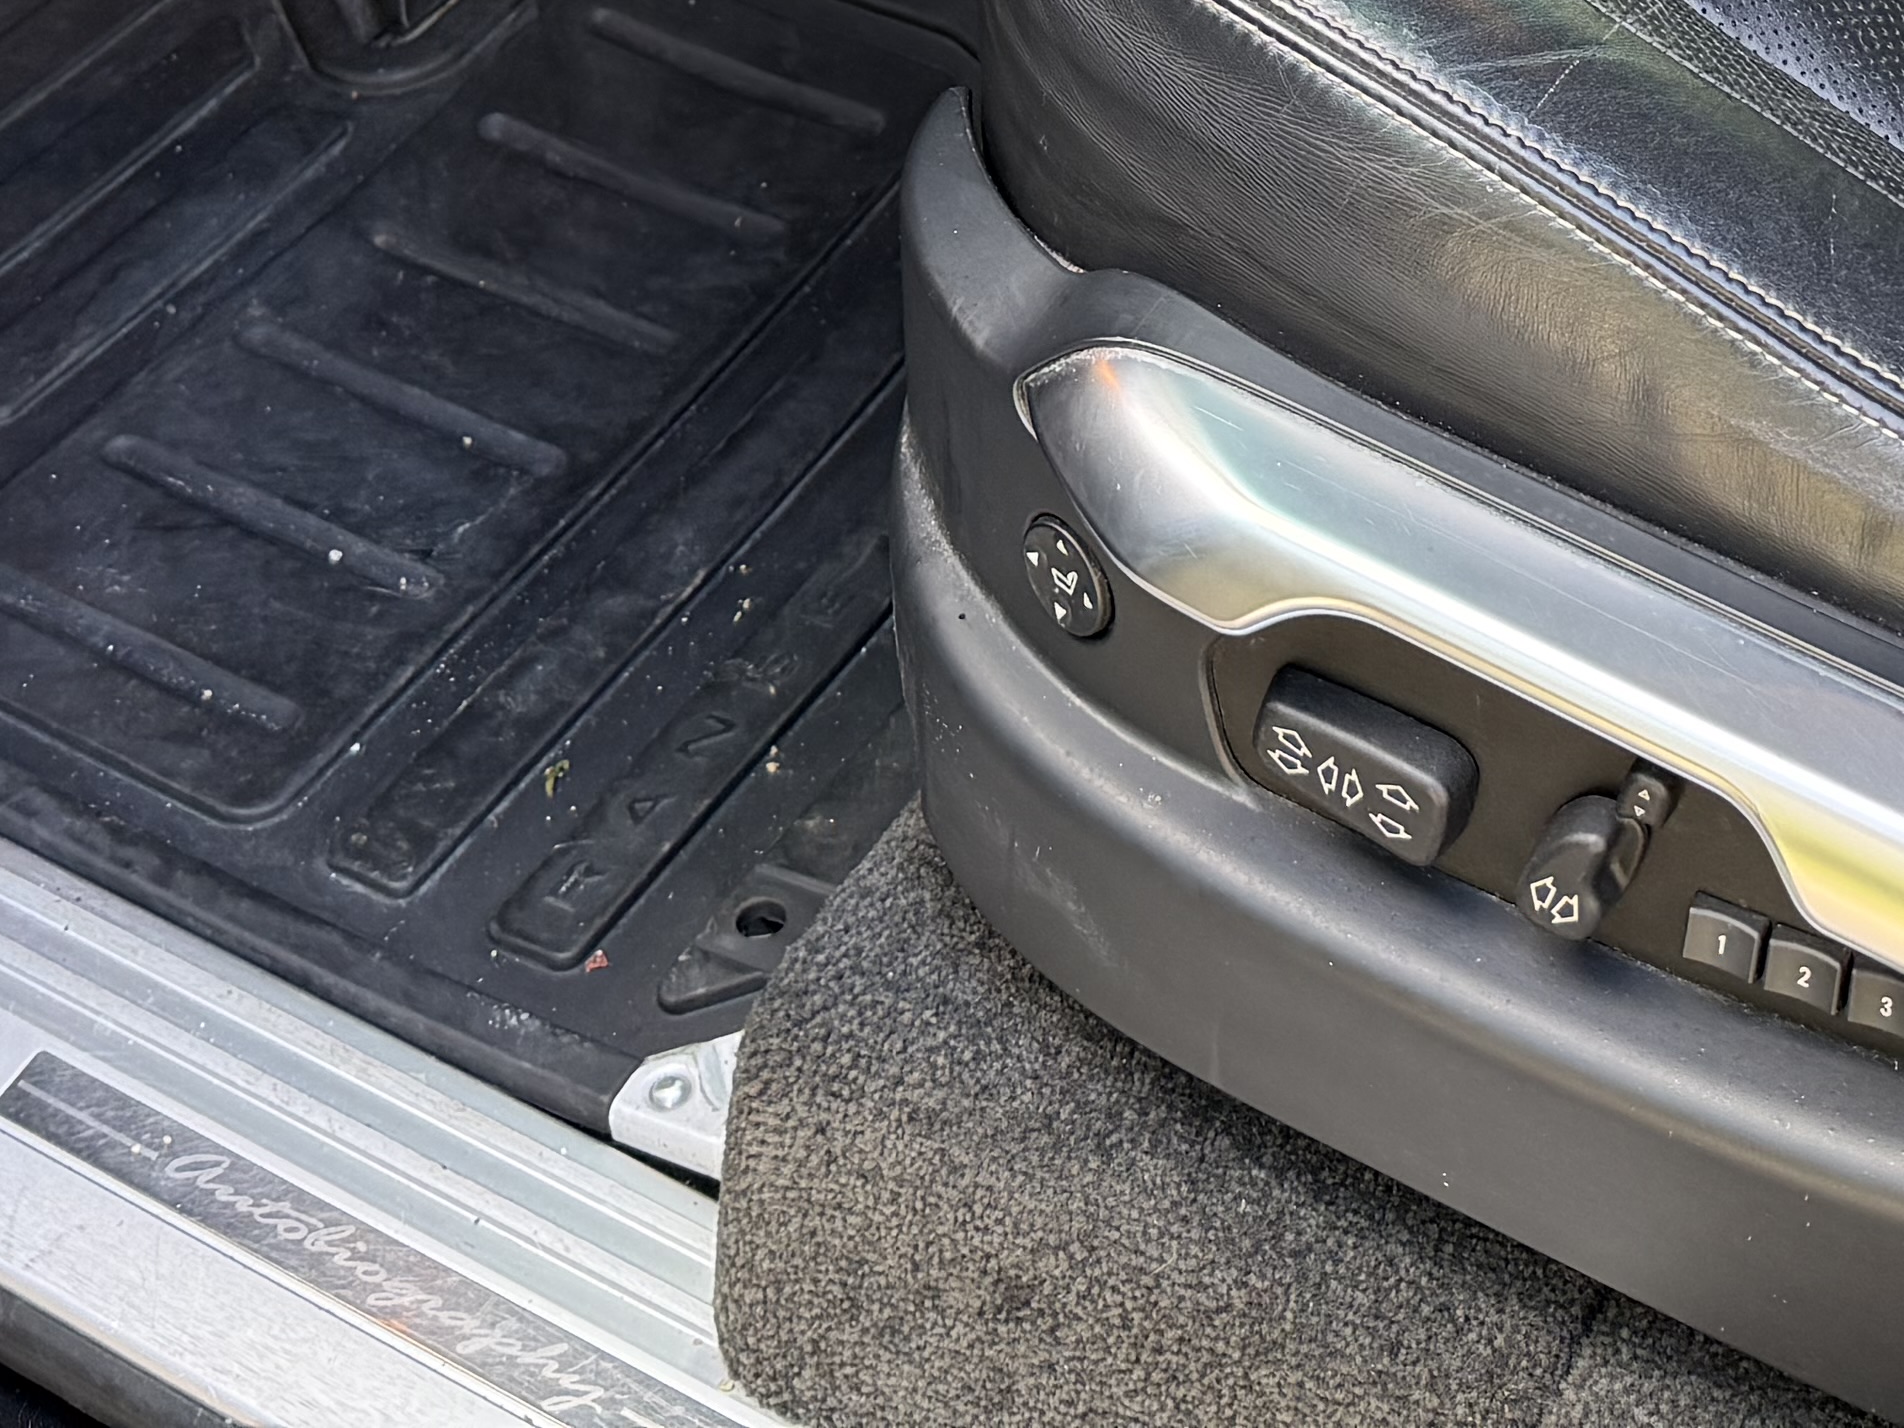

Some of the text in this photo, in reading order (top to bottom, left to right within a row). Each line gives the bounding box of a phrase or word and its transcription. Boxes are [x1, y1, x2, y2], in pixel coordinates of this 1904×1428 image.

[1717, 934, 1727, 955] 1
[1797, 966, 1812, 988] 2
[1879, 996, 1893, 1017] 3
